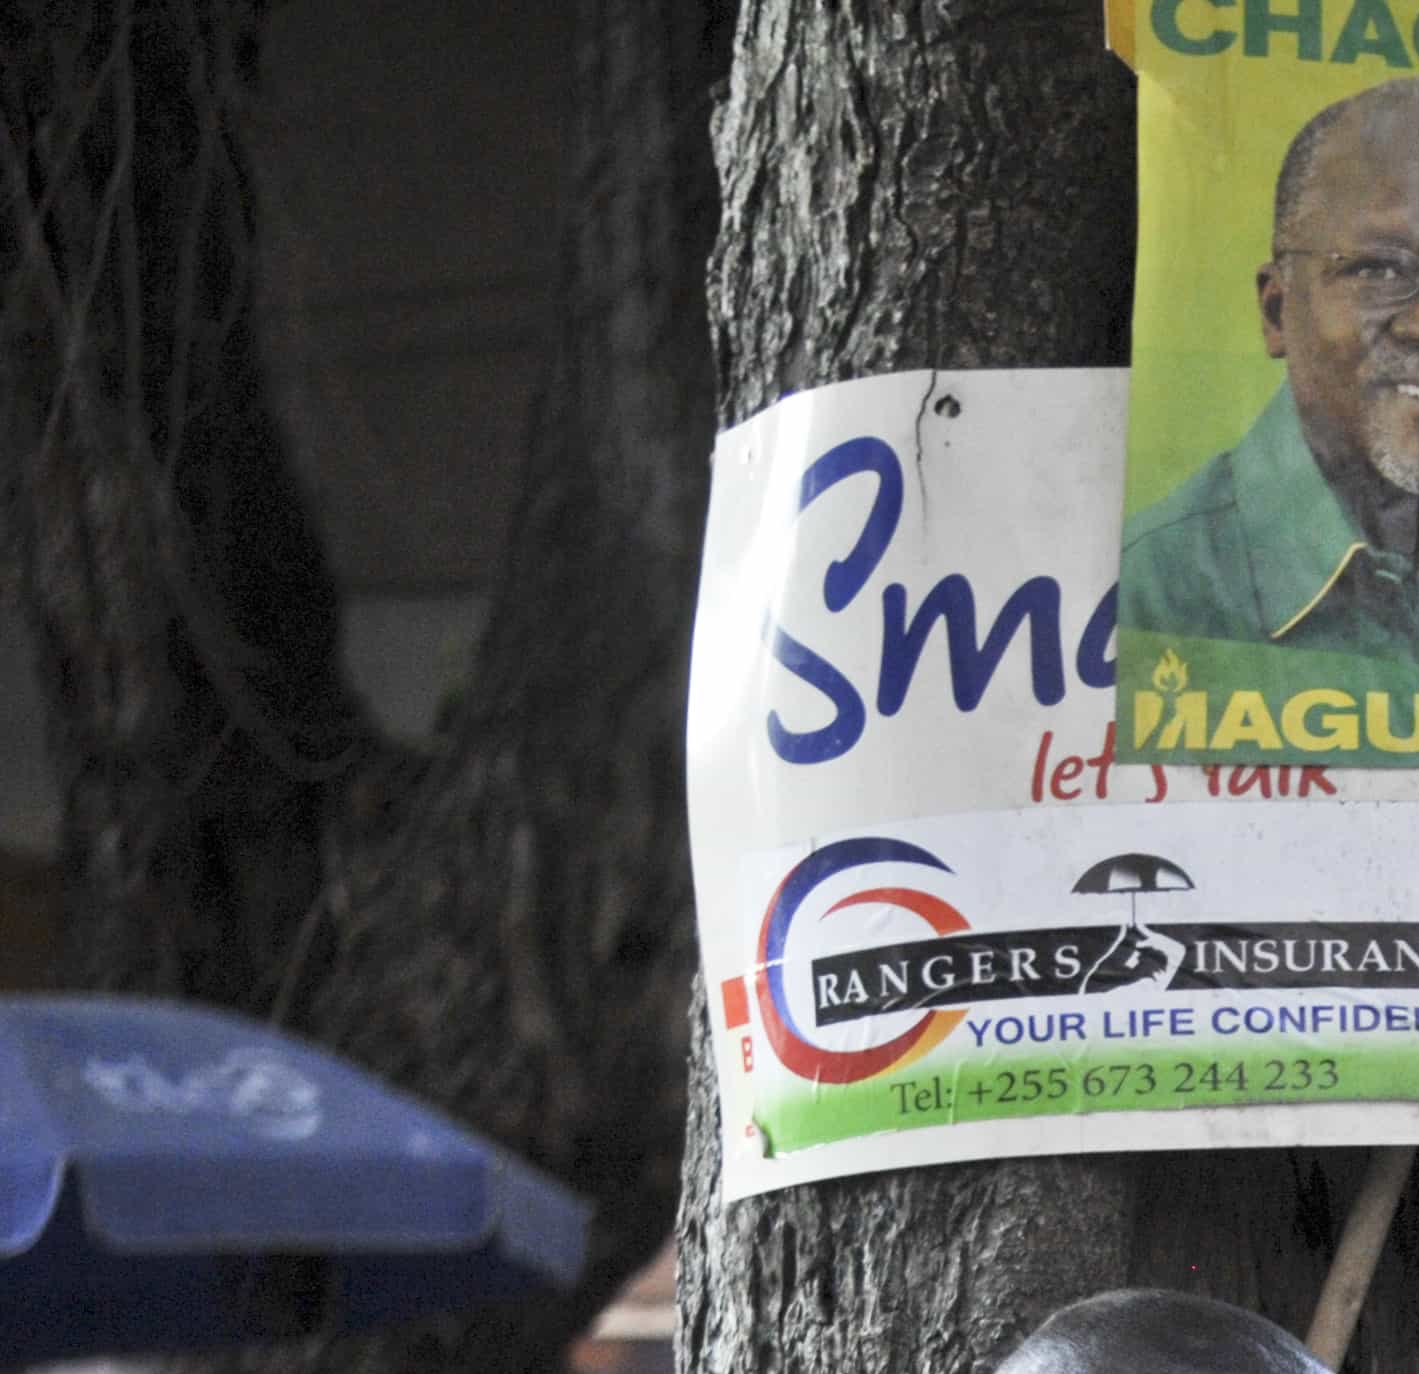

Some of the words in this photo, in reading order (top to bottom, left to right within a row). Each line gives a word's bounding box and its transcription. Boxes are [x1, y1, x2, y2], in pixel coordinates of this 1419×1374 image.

[817, 944, 1082, 1009] RANGERS
[967, 1011, 1087, 1048] YOUR
[1102, 1007, 1196, 1039] LIFE
[890, 1075, 953, 1115] Tel:
[967, 1066, 1069, 1107] +255
[1082, 1063, 1157, 1098] 673
[1173, 1060, 1249, 1094] 244
[1263, 1058, 1340, 1093] 233
